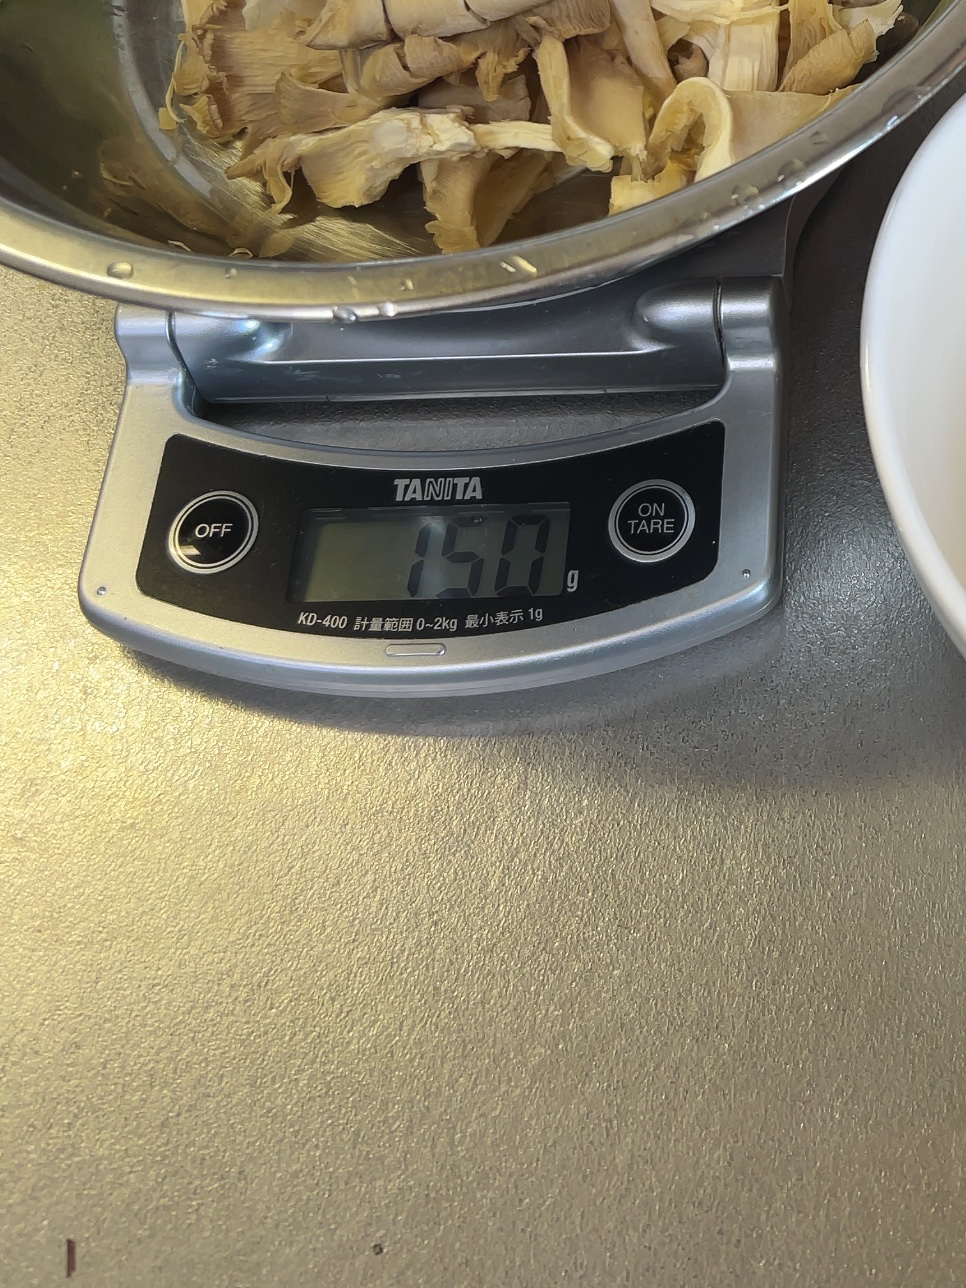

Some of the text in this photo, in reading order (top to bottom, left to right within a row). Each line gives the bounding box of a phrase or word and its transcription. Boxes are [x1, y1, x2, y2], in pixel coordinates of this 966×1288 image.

[394, 477, 483, 501] TANITA
[638, 503, 665, 517] ON
[194, 523, 233, 538] OFF
[627, 519, 675, 534] TARE
[407, 513, 550, 598] 150
[567, 569, 579, 592] g
[297, 612, 347, 629] KD-400
[353, 616, 413, 632] 計量範囲
[465, 610, 524, 629] 最小表示
[528, 608, 543, 621] 1g
